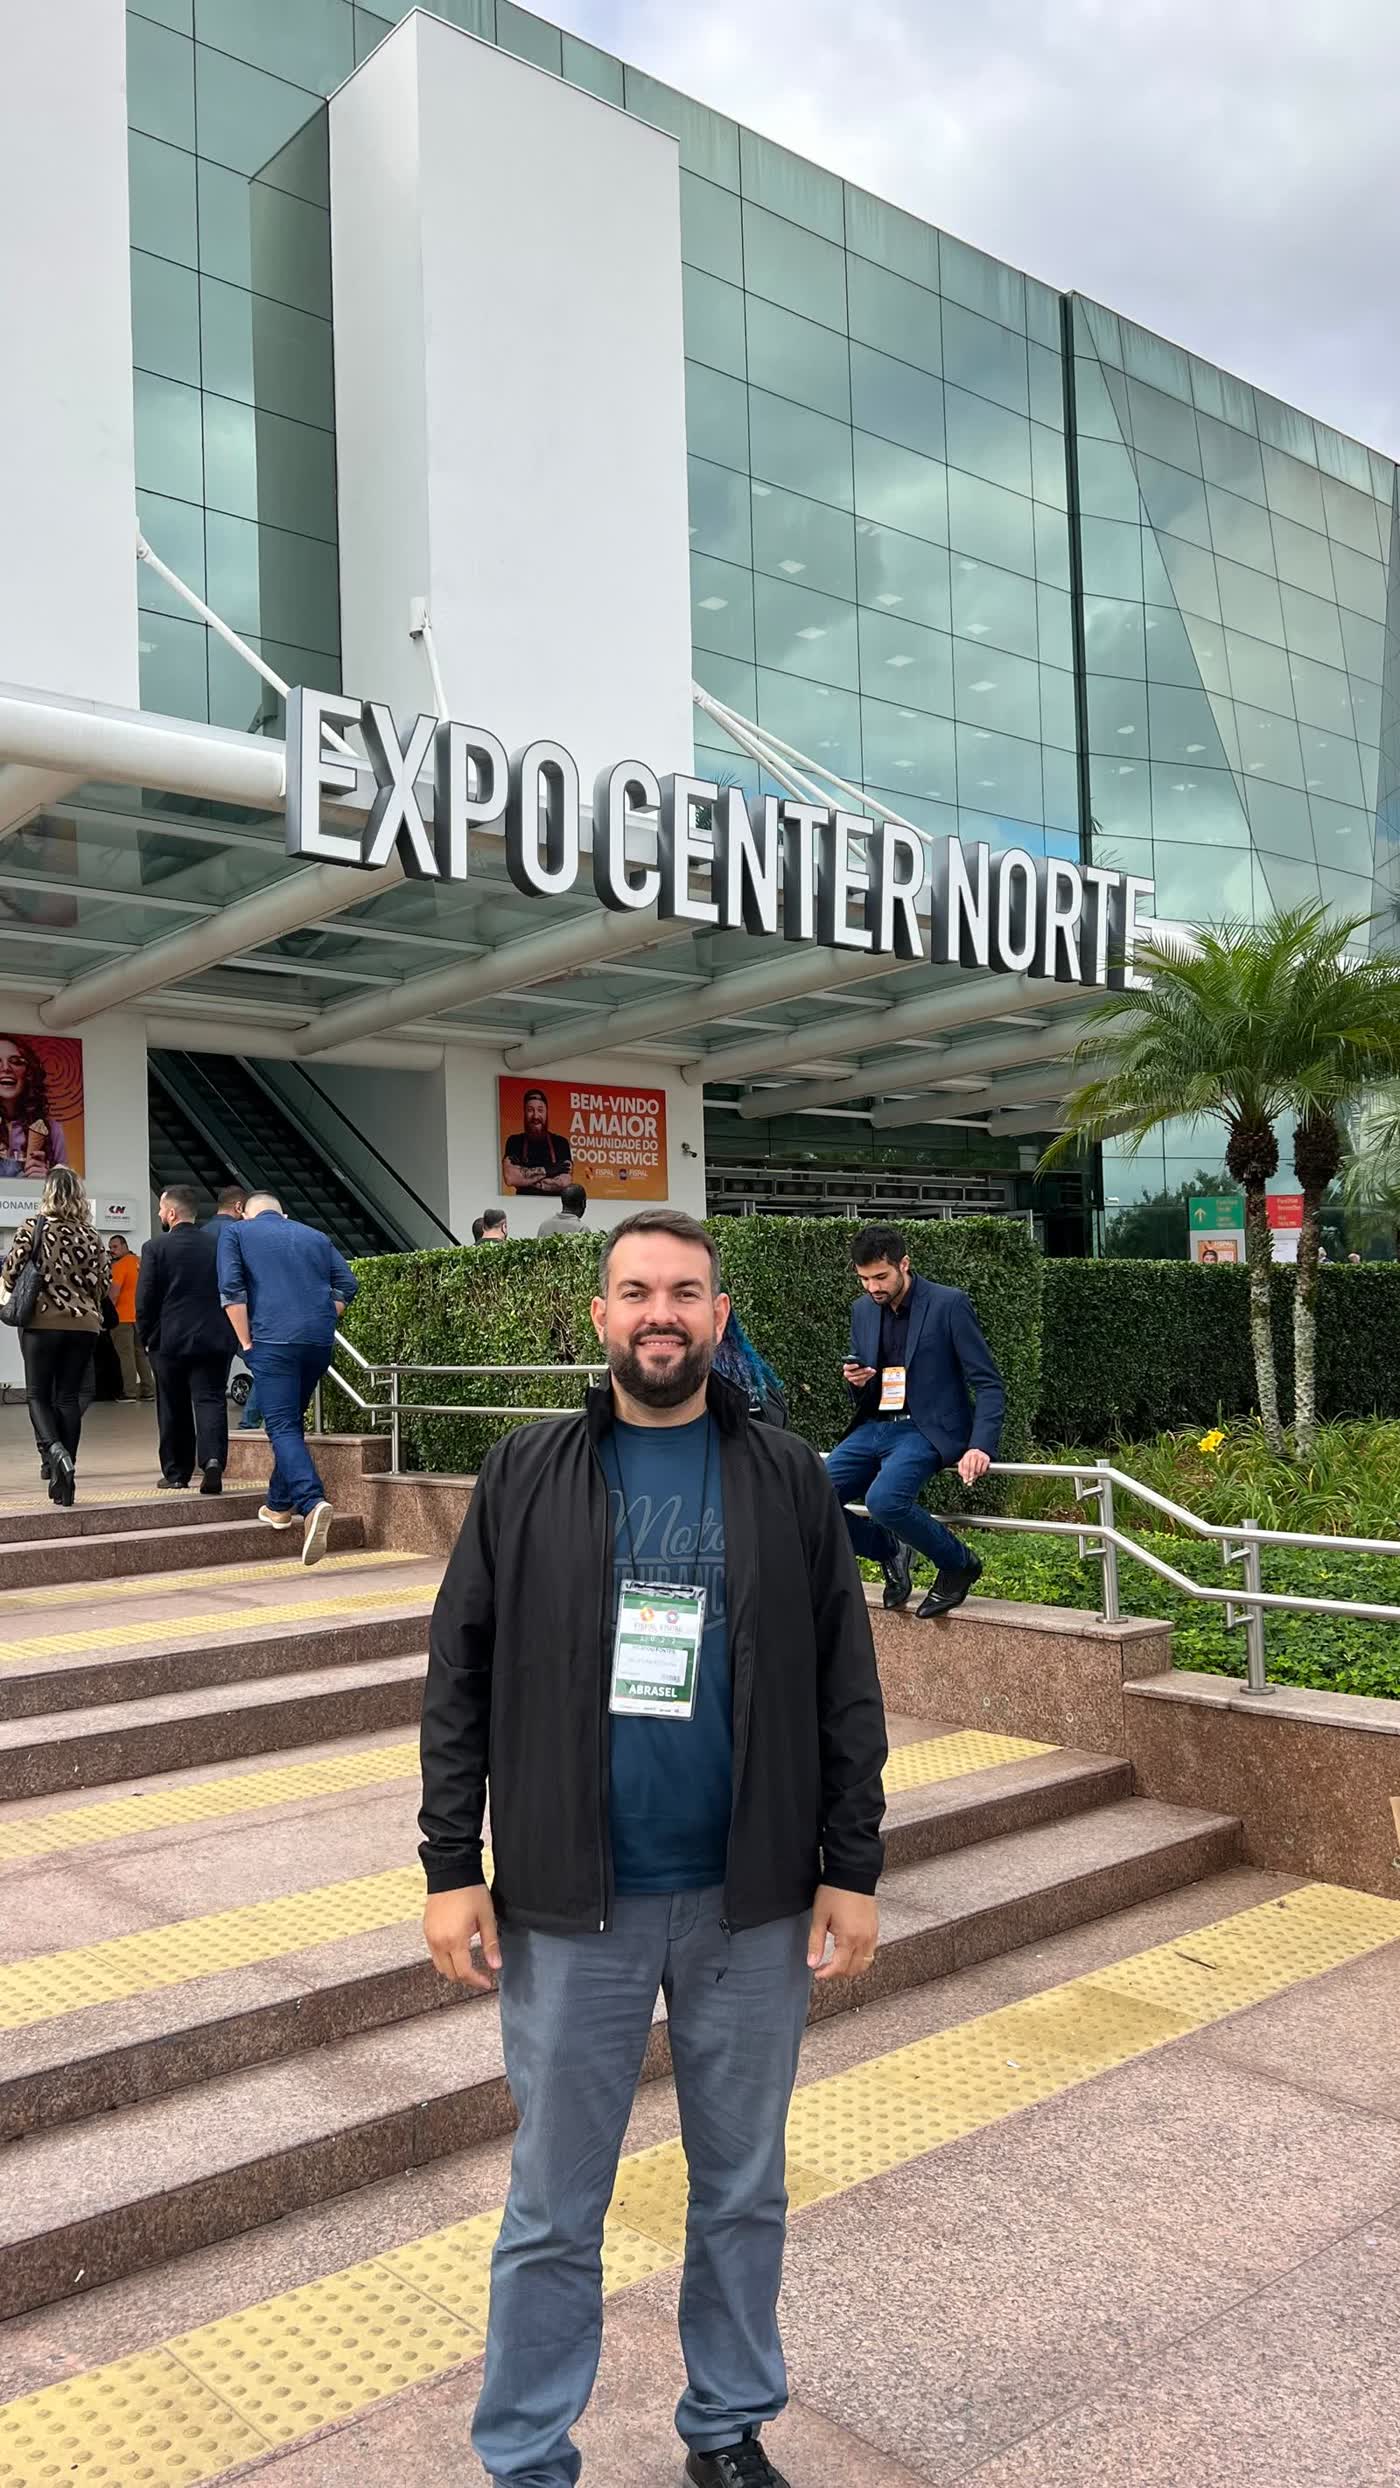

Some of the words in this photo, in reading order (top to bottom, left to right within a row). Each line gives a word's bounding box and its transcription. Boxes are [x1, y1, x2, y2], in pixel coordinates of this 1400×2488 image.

[286, 685, 579, 897] EXPO
[593, 759, 925, 962] CENTER
[931, 834, 1156, 992] NORTE
[570, 1092, 659, 1115] BEM-VINDO
[570, 1111, 585, 1134] A
[589, 1113, 657, 1138] MAIOR
[570, 1134, 640, 1151] COMUNIDADE
[642, 1140, 658, 1151] DO
[570, 1149, 607, 1164] FOOD
[609, 1151, 658, 1166] SERVICE
[628, 1684, 678, 1698] ABRASEL
